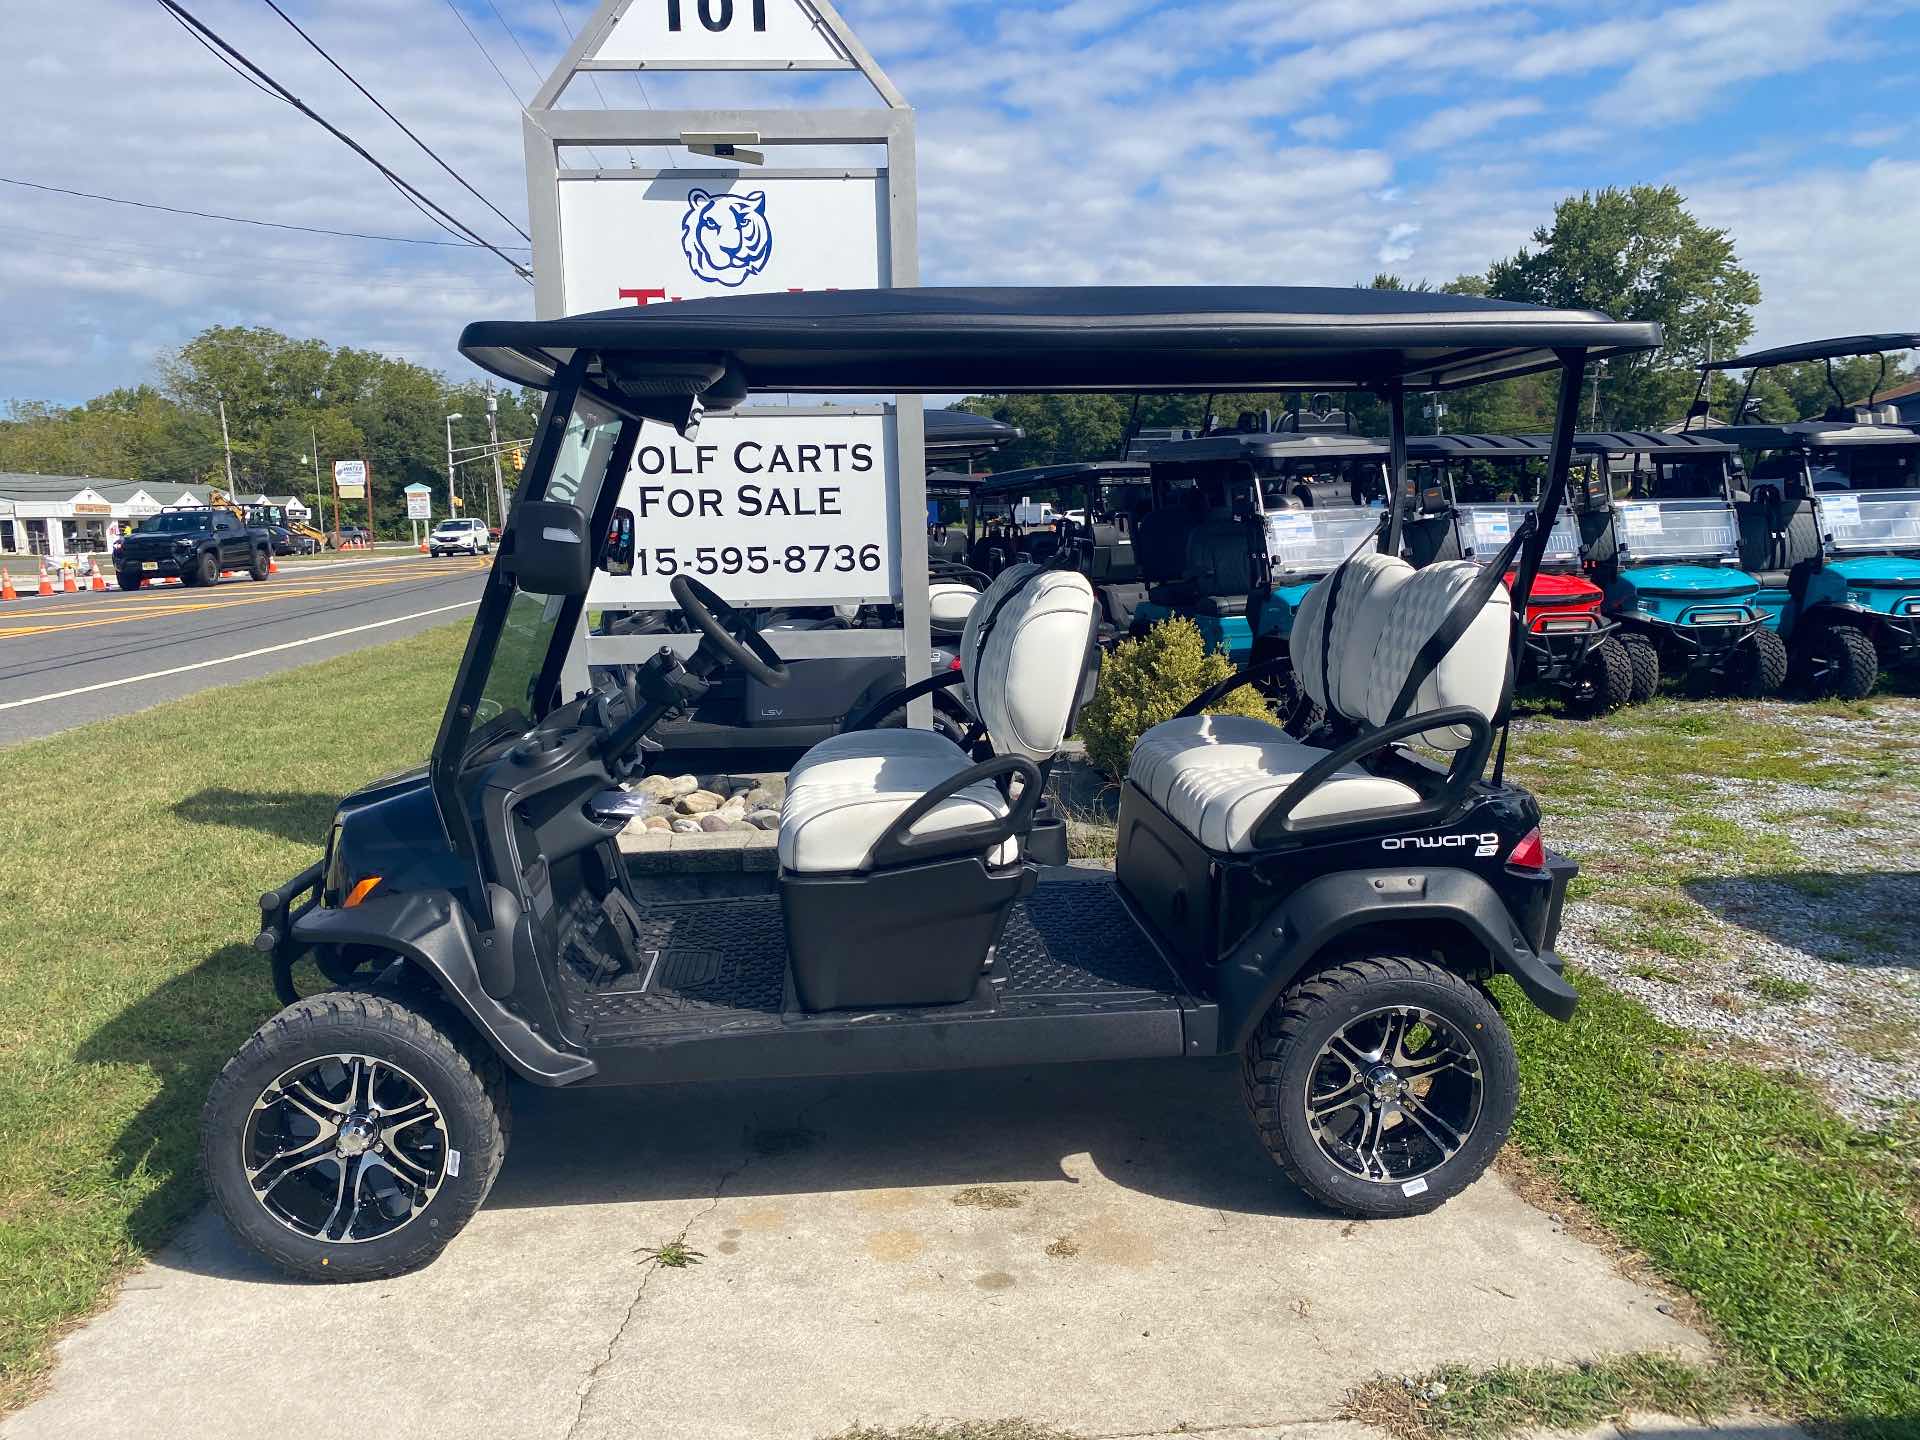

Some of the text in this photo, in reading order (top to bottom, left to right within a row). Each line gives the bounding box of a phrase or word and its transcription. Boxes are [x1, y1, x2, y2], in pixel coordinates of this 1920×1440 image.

[629, 441, 873, 474] OLF CARTS
[639, 484, 842, 518] FOR SALE
[637, 544, 881, 576] 15-595-8736
[761, 708, 784, 716] LSV
